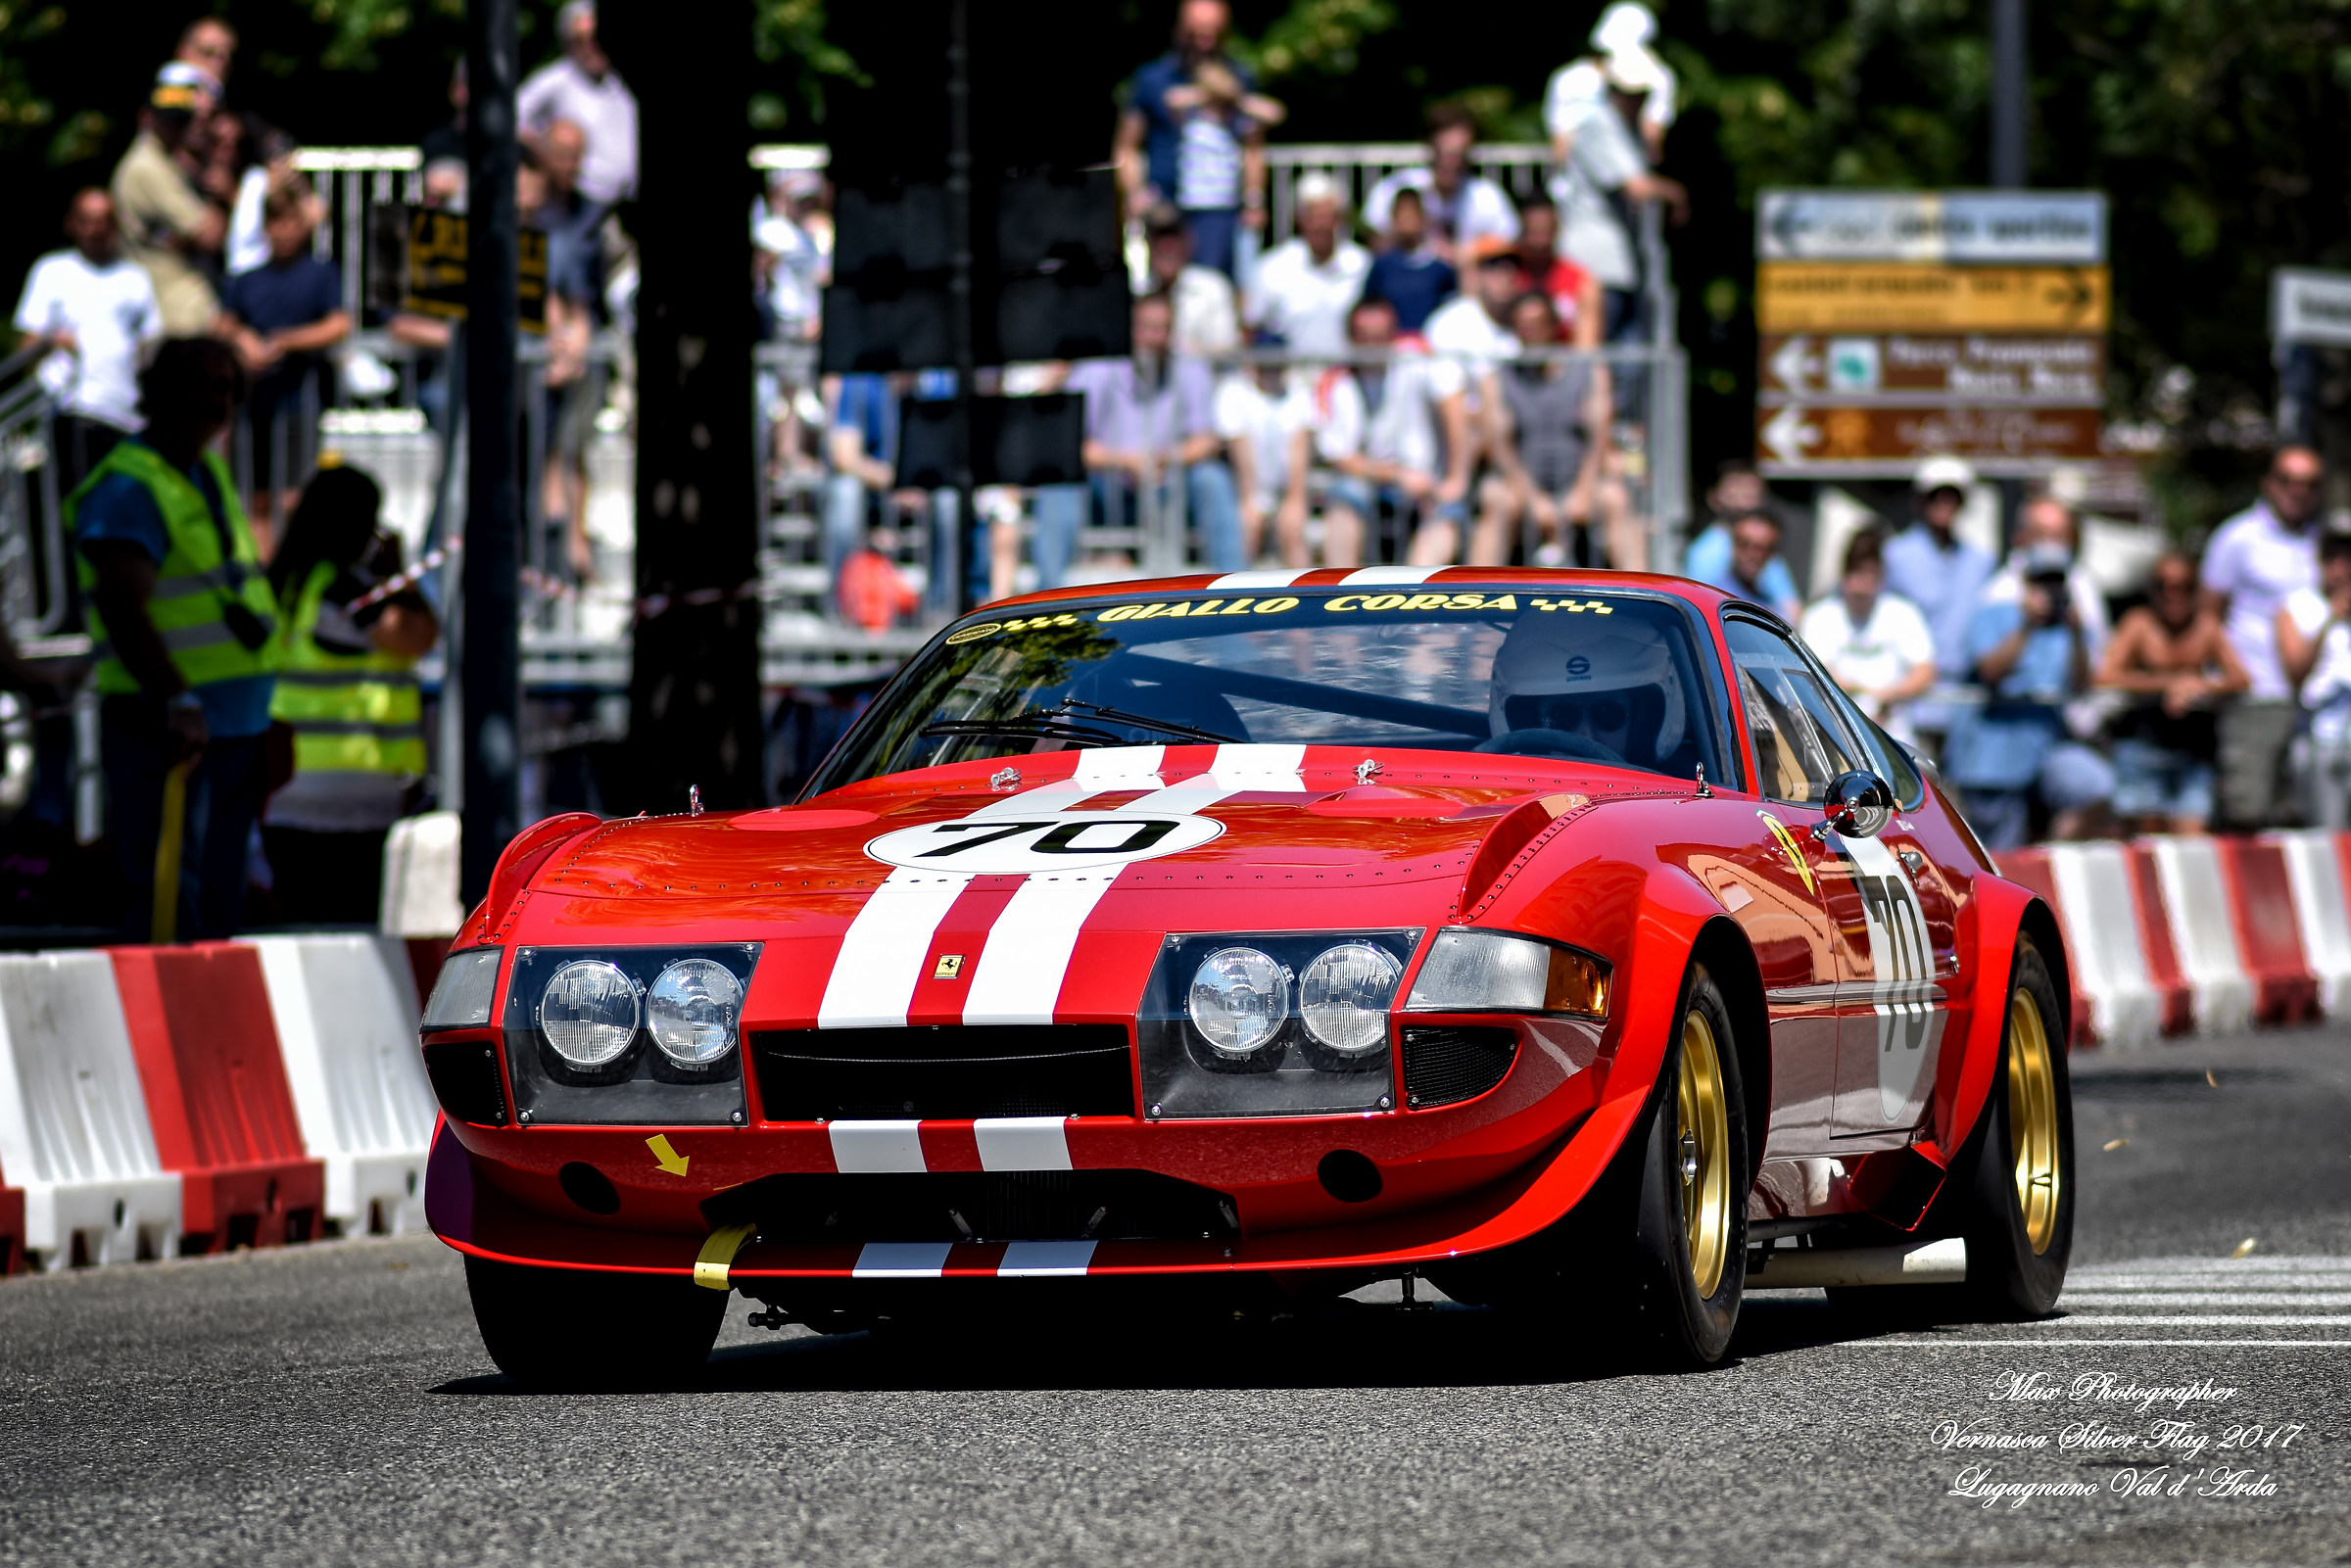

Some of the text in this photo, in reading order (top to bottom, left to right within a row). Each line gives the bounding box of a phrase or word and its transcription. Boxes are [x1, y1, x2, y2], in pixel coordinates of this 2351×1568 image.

[1096, 594, 1517, 622] GIALLO CORSA
[913, 820, 1180, 858] 70
[1860, 875, 1927, 1052] 70
